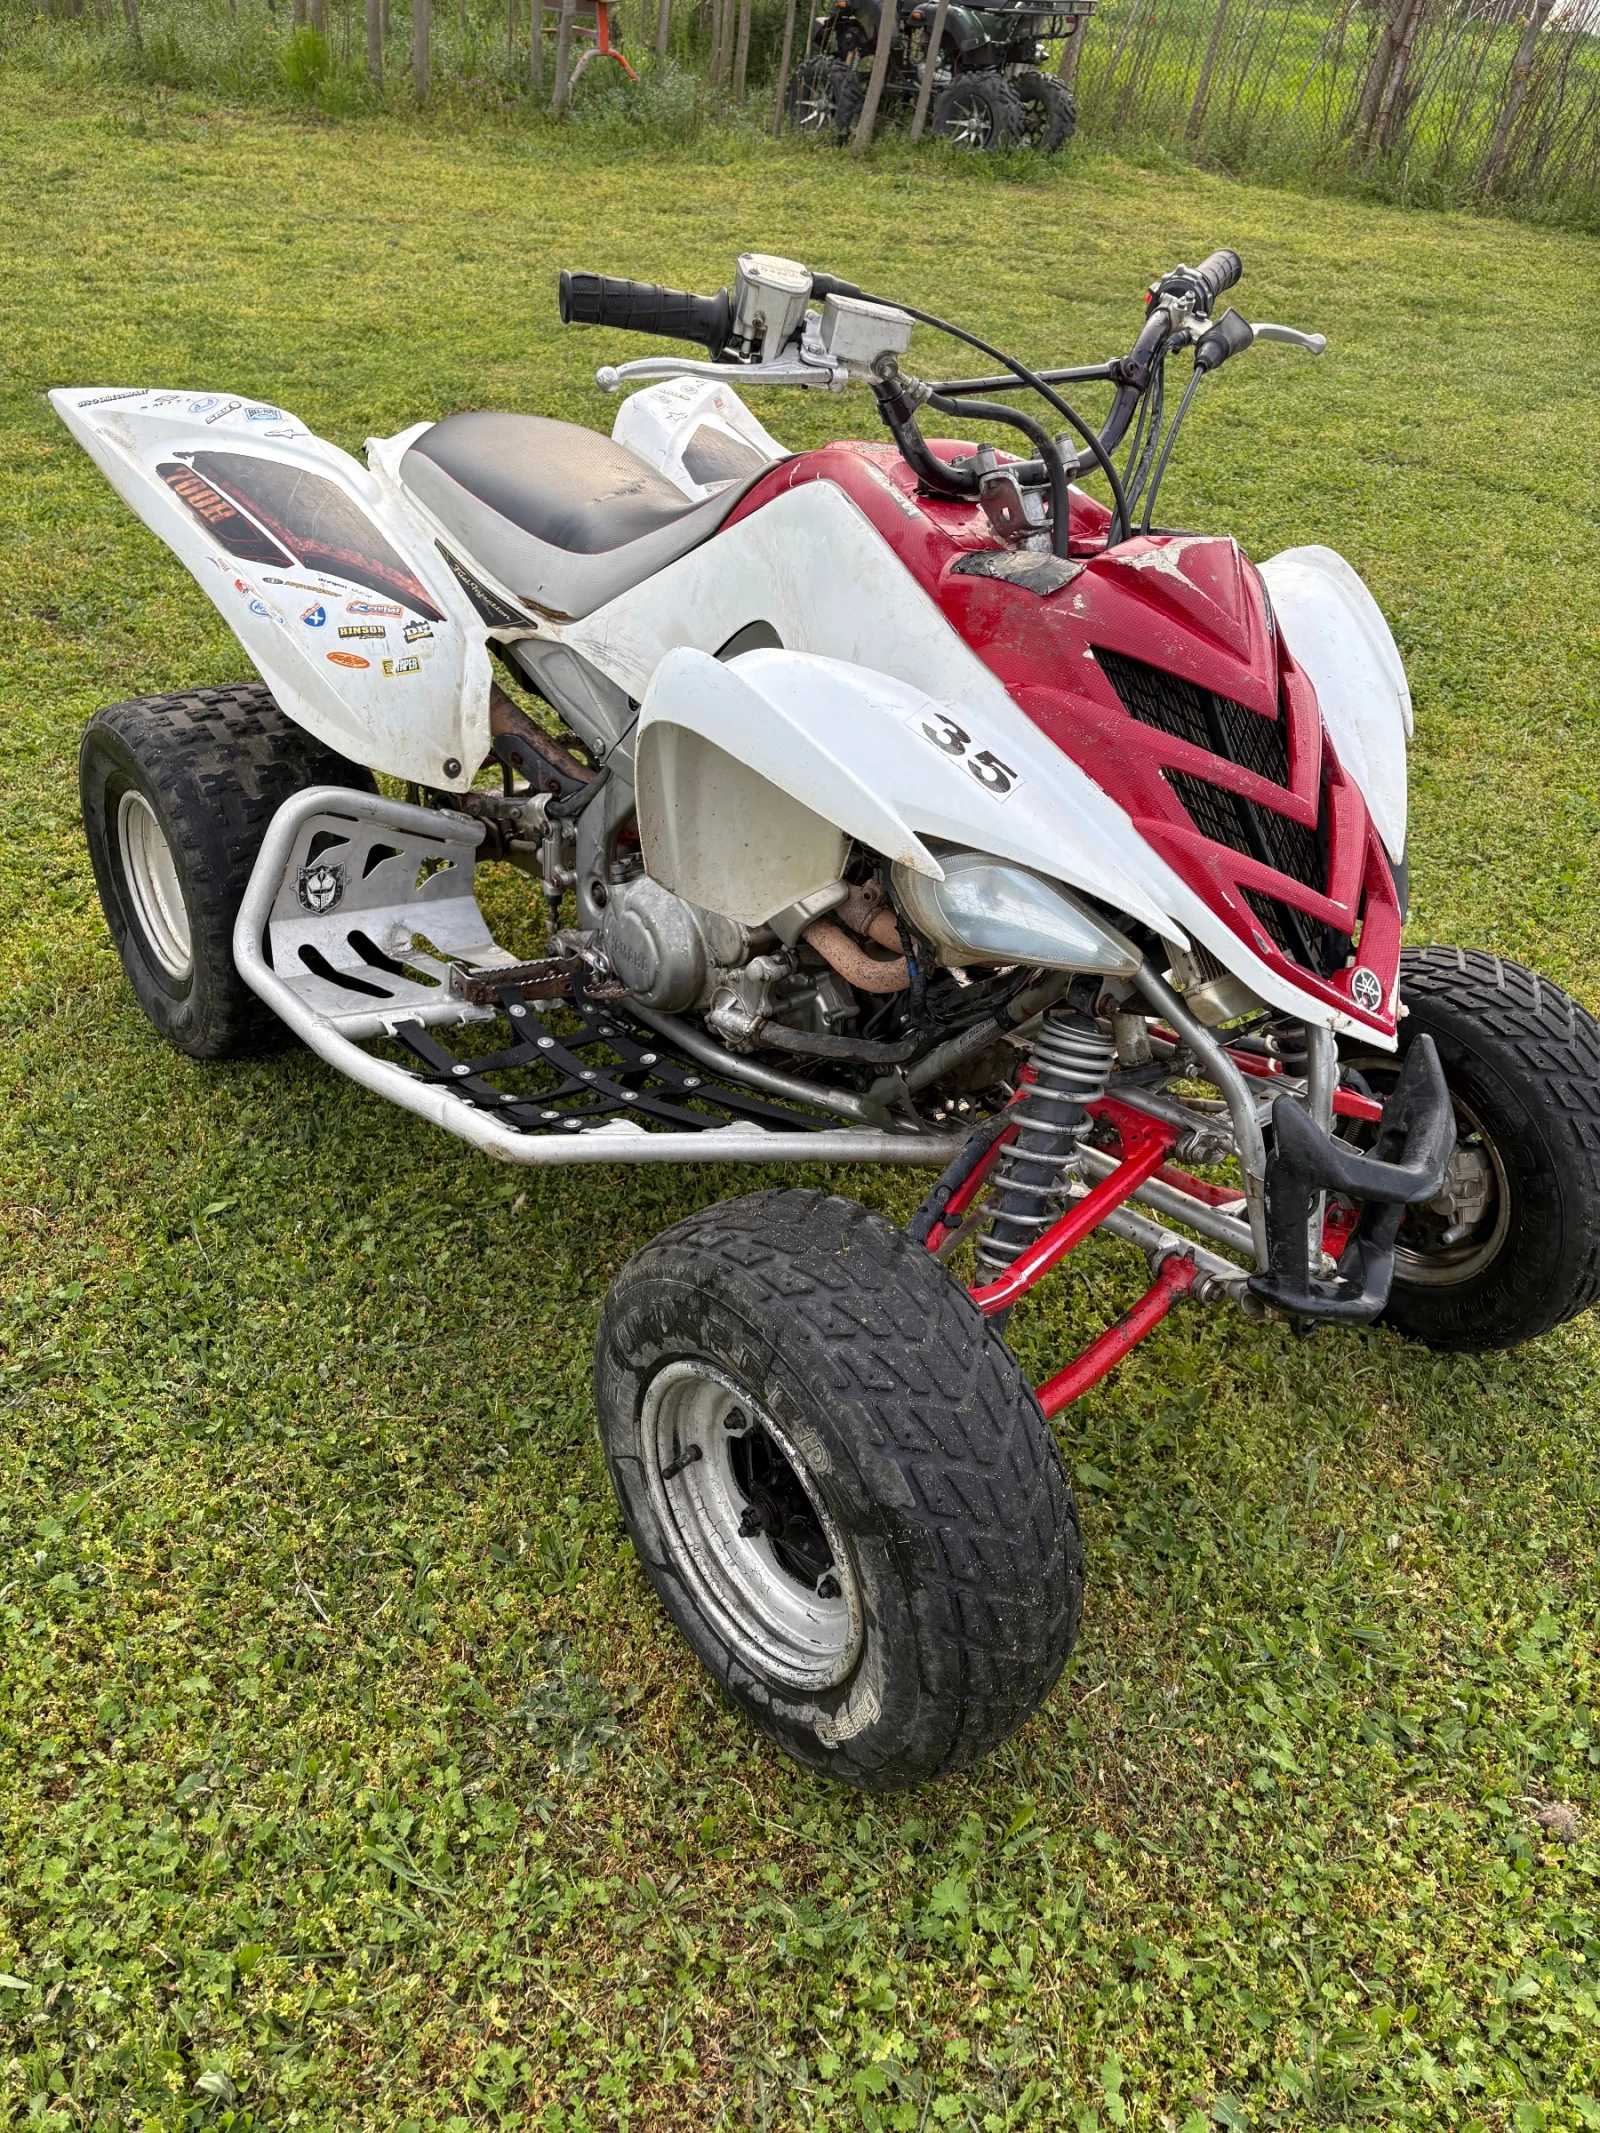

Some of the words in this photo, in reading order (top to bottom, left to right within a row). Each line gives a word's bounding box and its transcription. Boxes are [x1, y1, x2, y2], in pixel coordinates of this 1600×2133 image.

[164, 466, 237, 524] 700R
[450, 563, 471, 586] Fuel
[470, 582, 512, 622] Injection
[339, 625, 385, 636] HINSON
[921, 712, 1018, 794] 35
[812, 1684, 882, 1750] GOLDSPEED
